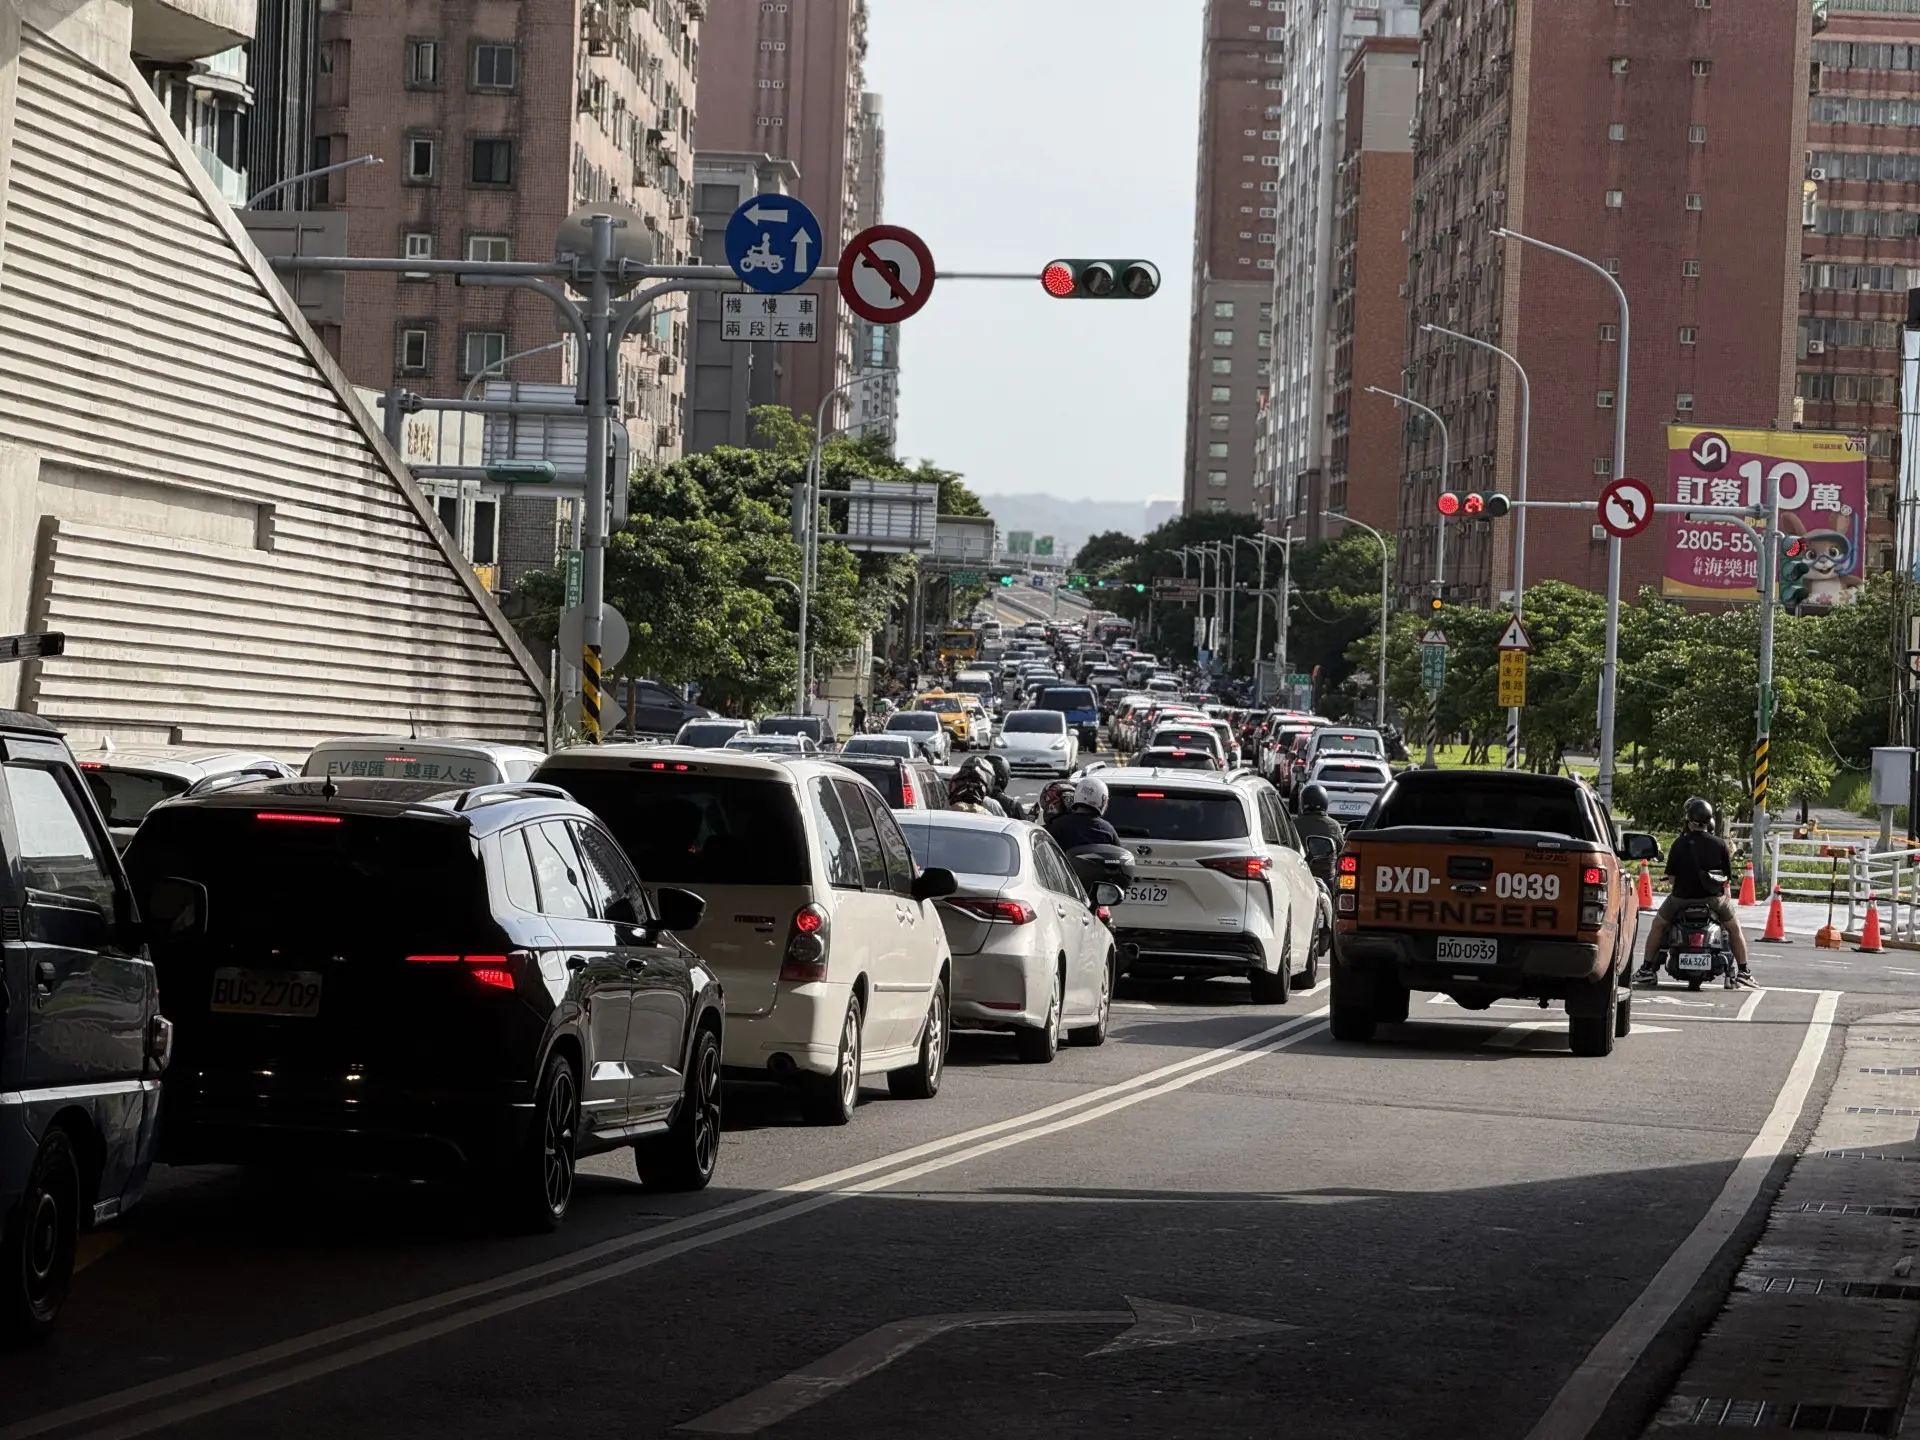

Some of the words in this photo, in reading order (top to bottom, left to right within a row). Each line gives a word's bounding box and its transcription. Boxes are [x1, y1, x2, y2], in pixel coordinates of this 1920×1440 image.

[726, 297, 813, 314] 機慢車
[725, 321, 814, 338] 兩段左轉
[1513, 653, 1524, 704] 前方路口
[327, 760, 385, 777] EV智匯
[403, 762, 477, 784] 雙車人生
[1124, 887, 1168, 902] FS-6129
[1376, 866, 1440, 893] BXD-
[1496, 872, 1560, 900] 0939
[1374, 897, 1558, 929] RANGER
